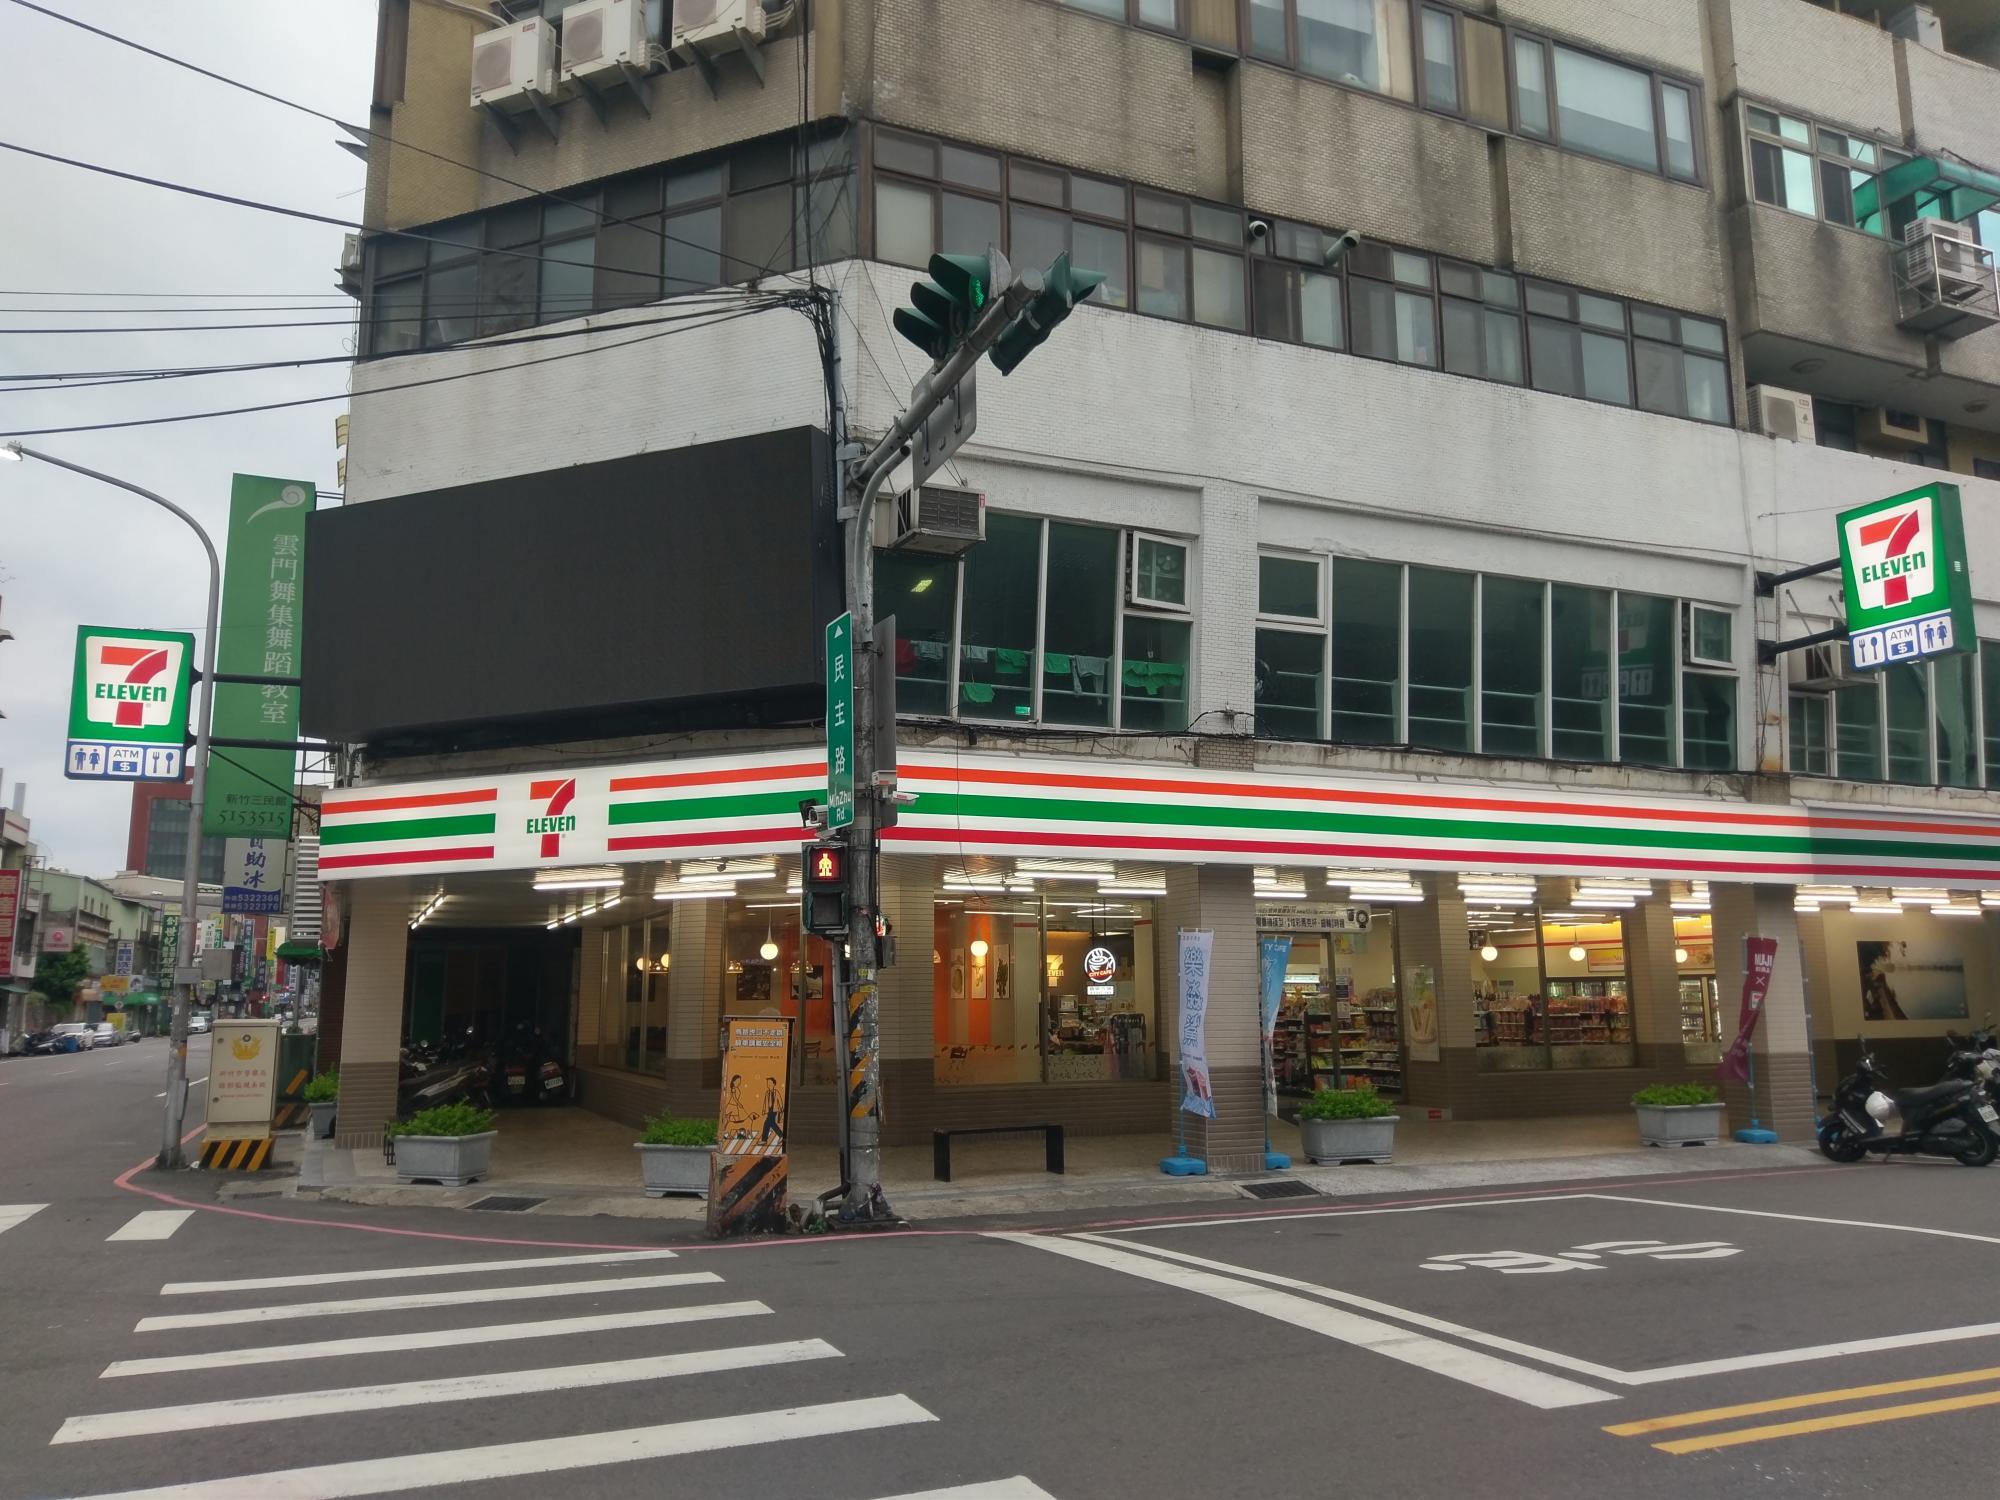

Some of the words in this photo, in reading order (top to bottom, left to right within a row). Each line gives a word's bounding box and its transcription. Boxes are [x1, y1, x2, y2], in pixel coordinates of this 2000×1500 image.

[1860, 510, 1920, 606] 7
[260, 534, 300, 724] 雲門舞集舞蹈教室
[1890, 628, 1913, 641] ATM
[100, 645, 169, 726] 7
[834, 654, 846, 775] 民主路
[113, 749, 140, 759] ATM
[217, 809, 286, 827] 5153515
[225, 793, 288, 806] 新竹三民館
[529, 778, 576, 857] 7
